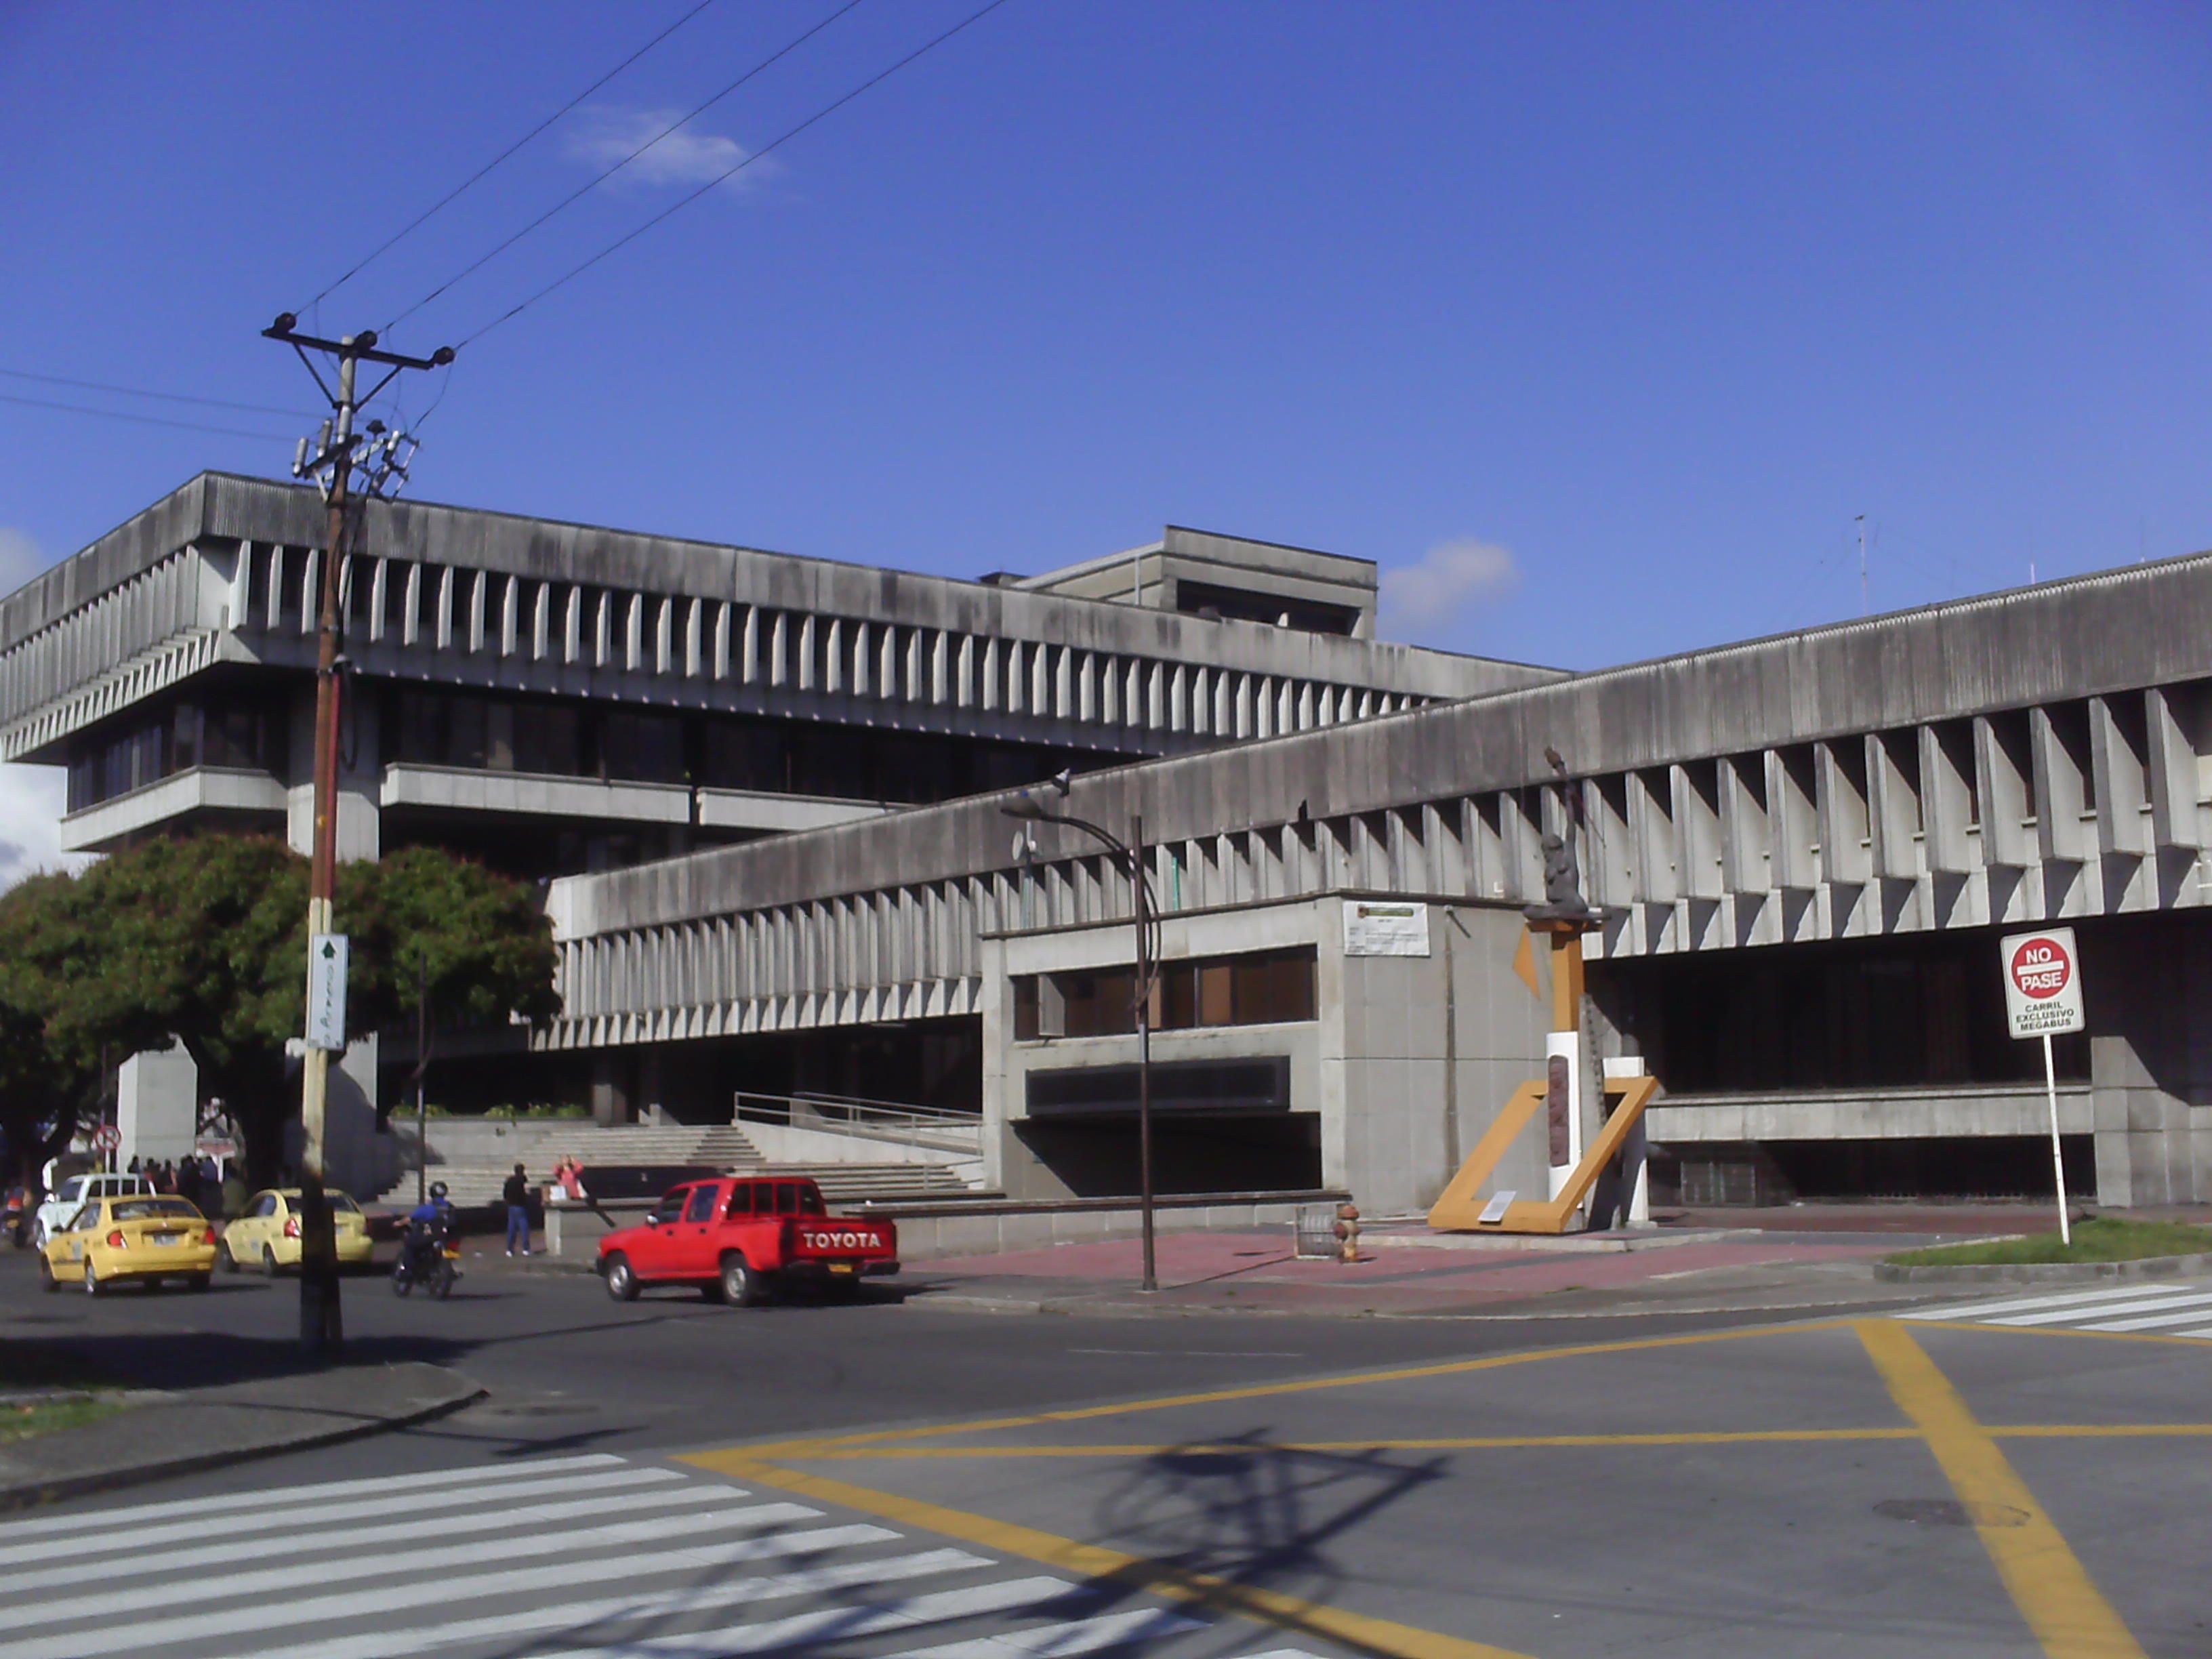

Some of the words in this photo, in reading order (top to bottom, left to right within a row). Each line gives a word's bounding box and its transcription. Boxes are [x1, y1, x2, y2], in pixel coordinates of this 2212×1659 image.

[2026, 947, 2052, 964] NO
[2022, 972, 2062, 991] PASE
[2025, 1001, 2063, 1012] CARRIL
[2015, 1008, 2074, 1023] EXCLUSIVO
[2020, 1019, 2071, 1031] MEGABUS
[803, 1232, 880, 1248] TOYOTA
